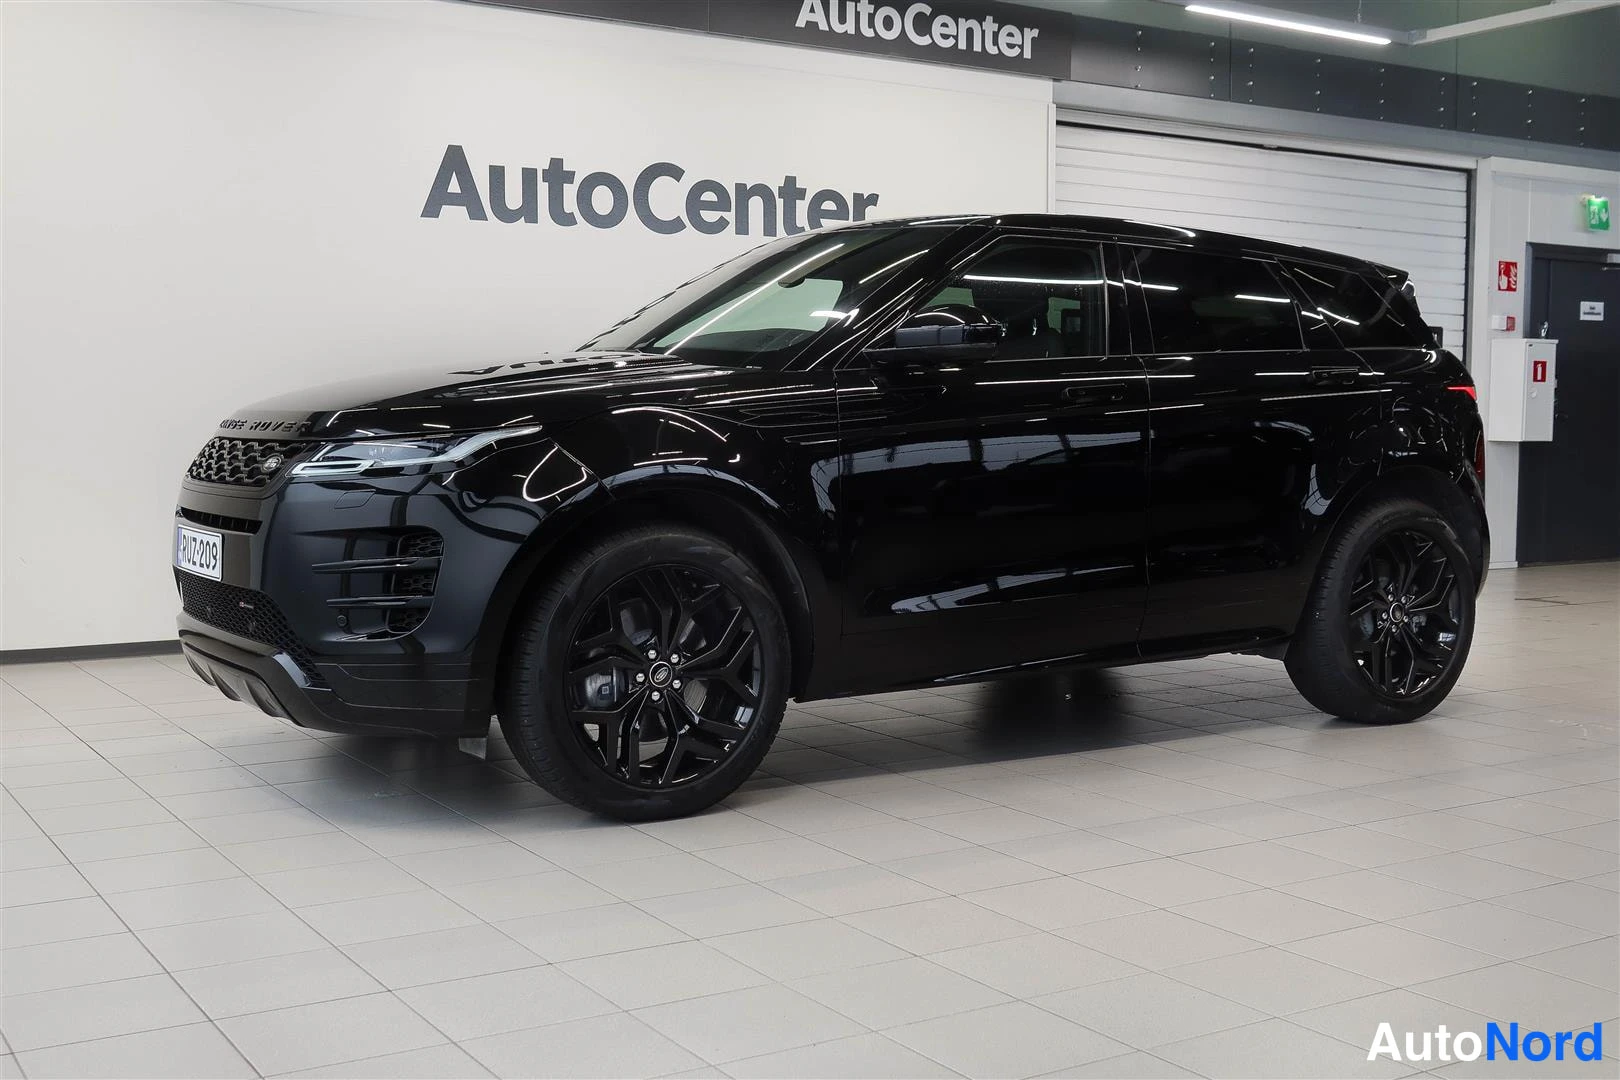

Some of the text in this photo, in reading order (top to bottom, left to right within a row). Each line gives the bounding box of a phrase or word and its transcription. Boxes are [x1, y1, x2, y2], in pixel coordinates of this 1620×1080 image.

[795, 0, 1040, 60] AutoCenter
[420, 144, 880, 238] AutoCenter
[182, 534, 219, 571] RUZ-209
